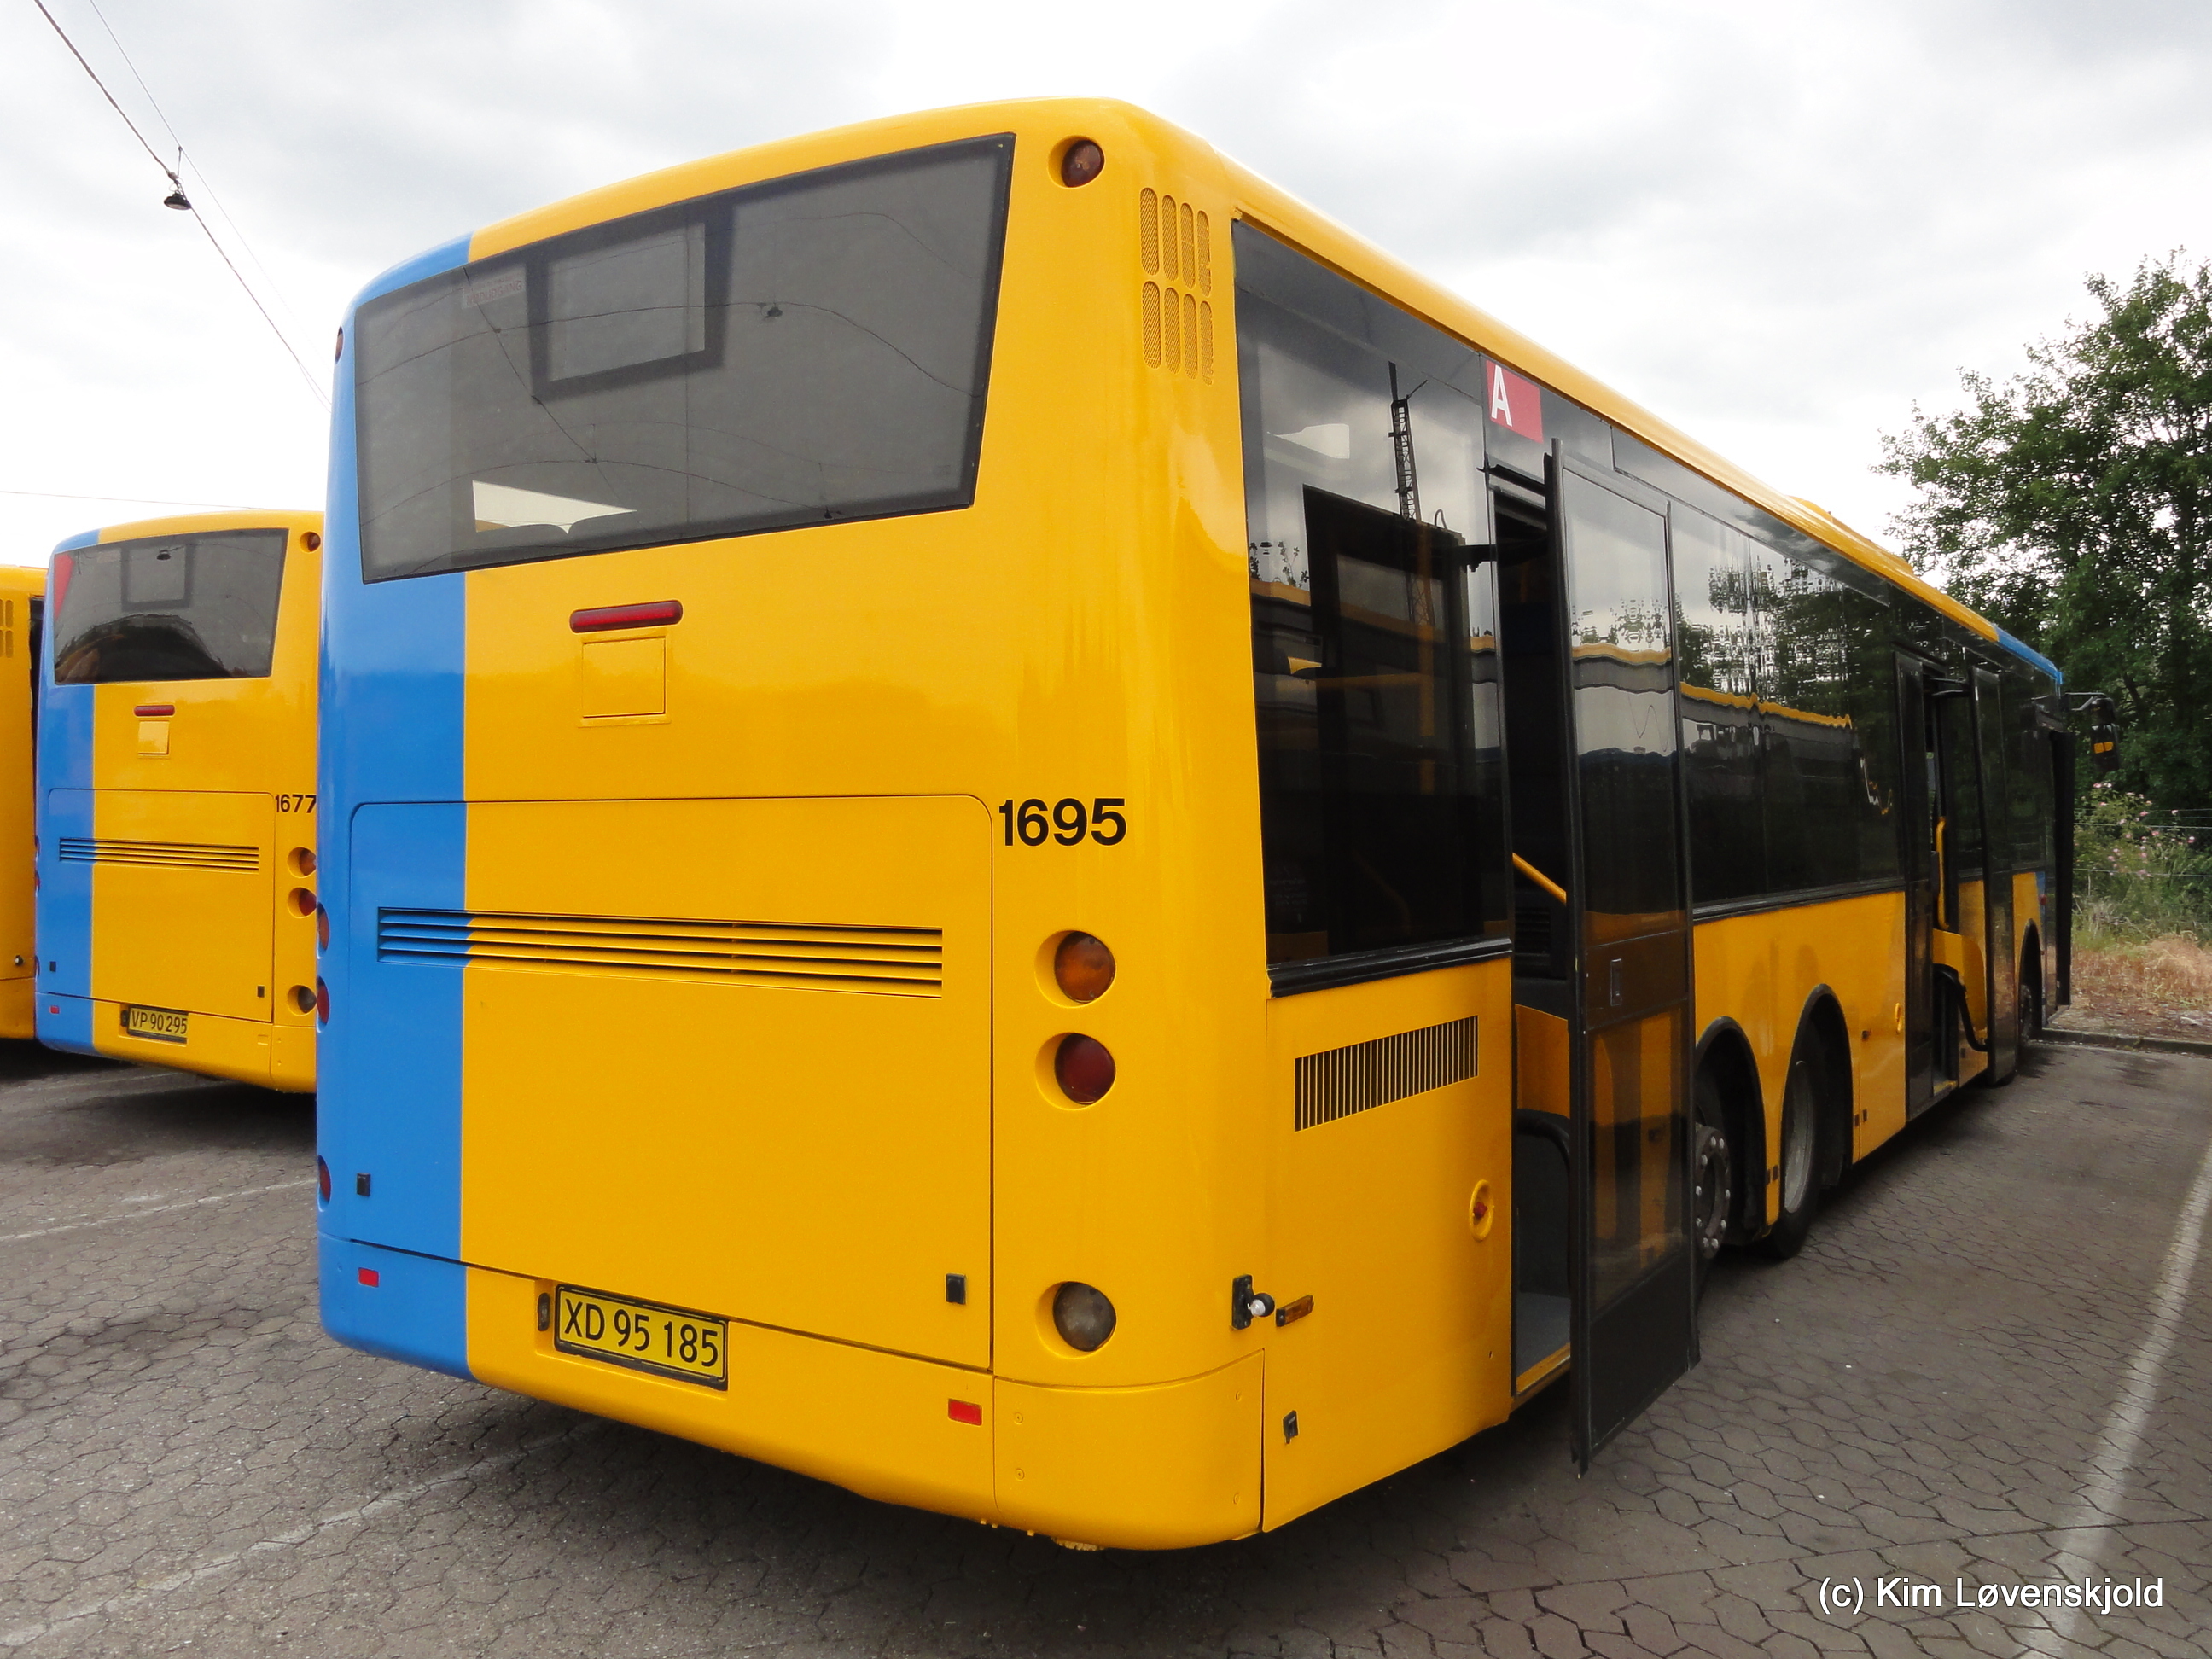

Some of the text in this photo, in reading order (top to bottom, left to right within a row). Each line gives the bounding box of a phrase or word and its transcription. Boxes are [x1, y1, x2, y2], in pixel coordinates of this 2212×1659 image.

[1491, 364, 1512, 427] A
[275, 794, 317, 813] 1677
[998, 798, 1126, 846] 1695
[131, 1010, 187, 1034] VP 90 295
[564, 1298, 719, 1367] XD 95 185
